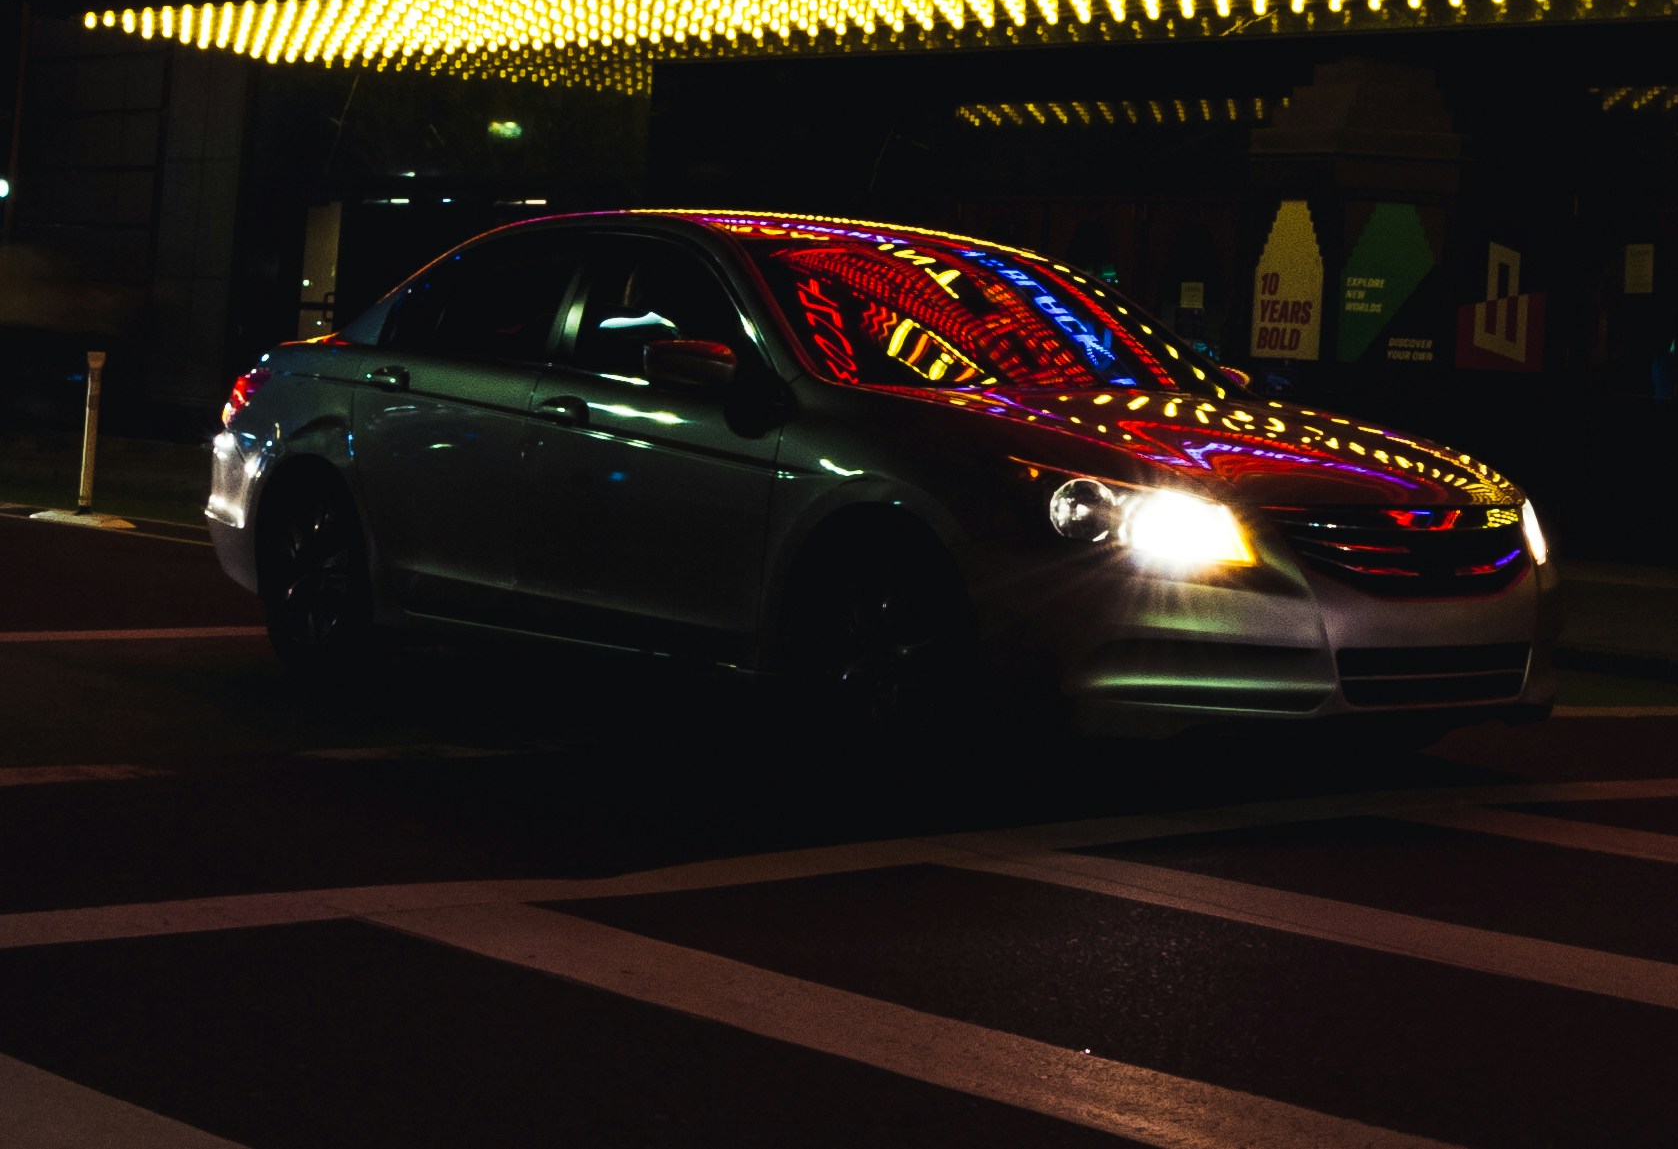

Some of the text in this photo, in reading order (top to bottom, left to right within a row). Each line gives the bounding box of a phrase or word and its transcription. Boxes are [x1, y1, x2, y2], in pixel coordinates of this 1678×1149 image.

[1260, 272, 1280, 296] 10
[1346, 277, 1386, 289] EXPLORE
[1345, 290, 1366, 299] NEW
[1259, 299, 1313, 325] YEARS
[1345, 302, 1383, 314] WORLDS
[1256, 326, 1302, 351] BOLD
[1388, 337, 1433, 349] DISCOVER
[1387, 350, 1410, 361] YOUR
